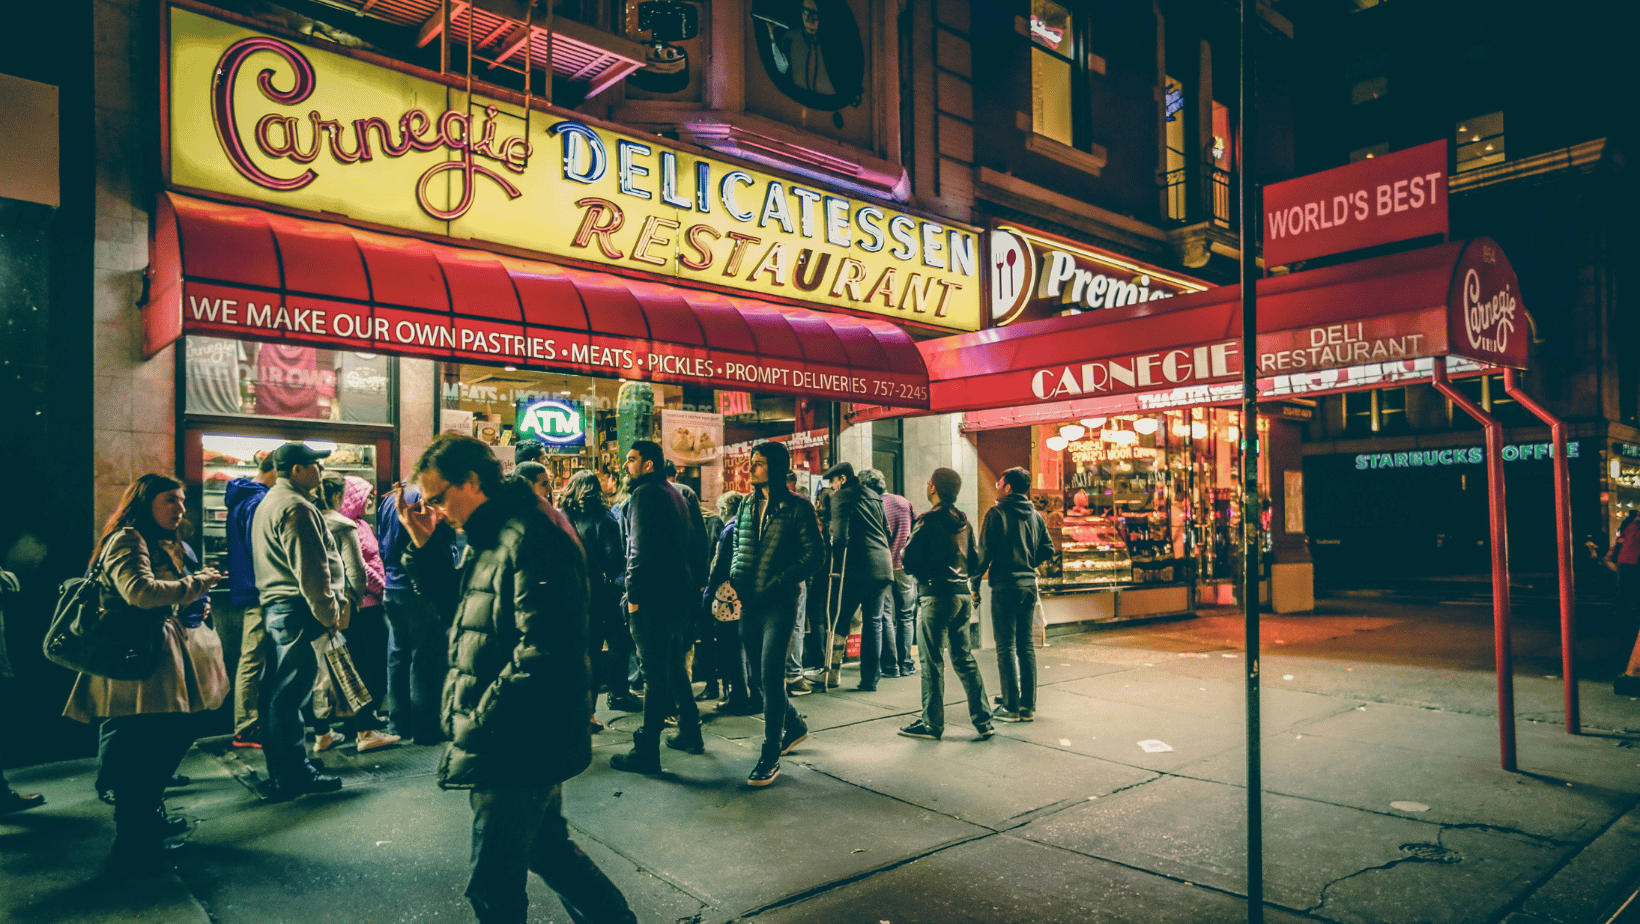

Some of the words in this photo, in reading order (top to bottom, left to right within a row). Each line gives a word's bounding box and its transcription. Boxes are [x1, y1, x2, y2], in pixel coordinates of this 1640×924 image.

[210, 36, 533, 220] Carnegie
[546, 121, 976, 277] DELICATESSEN
[1268, 190, 1369, 240] WORLD'S
[1376, 172, 1441, 216] BEST
[571, 196, 963, 317] RESTAURANT
[1310, 322, 1363, 347] DELI
[1463, 268, 1516, 353] Carnegie
[189, 296, 238, 325] WE
[246, 303, 327, 335] MAKE
[333, 313, 390, 341] OUR
[395, 321, 456, 349] OWN
[461, 328, 556, 360] PASTRIES
[571, 343, 633, 369] MEATS
[648, 353, 714, 377] PICKLES
[726, 362, 790, 387] PROMPT
[793, 370, 867, 394] DELIVERIES
[873, 380, 928, 400] 757-2245
[1031, 341, 1241, 399] CARNEGIE
[1260, 334, 1423, 372] RESTAURANT
[520, 409, 580, 434] ATM
[1355, 447, 1483, 470] STARBUCKS
